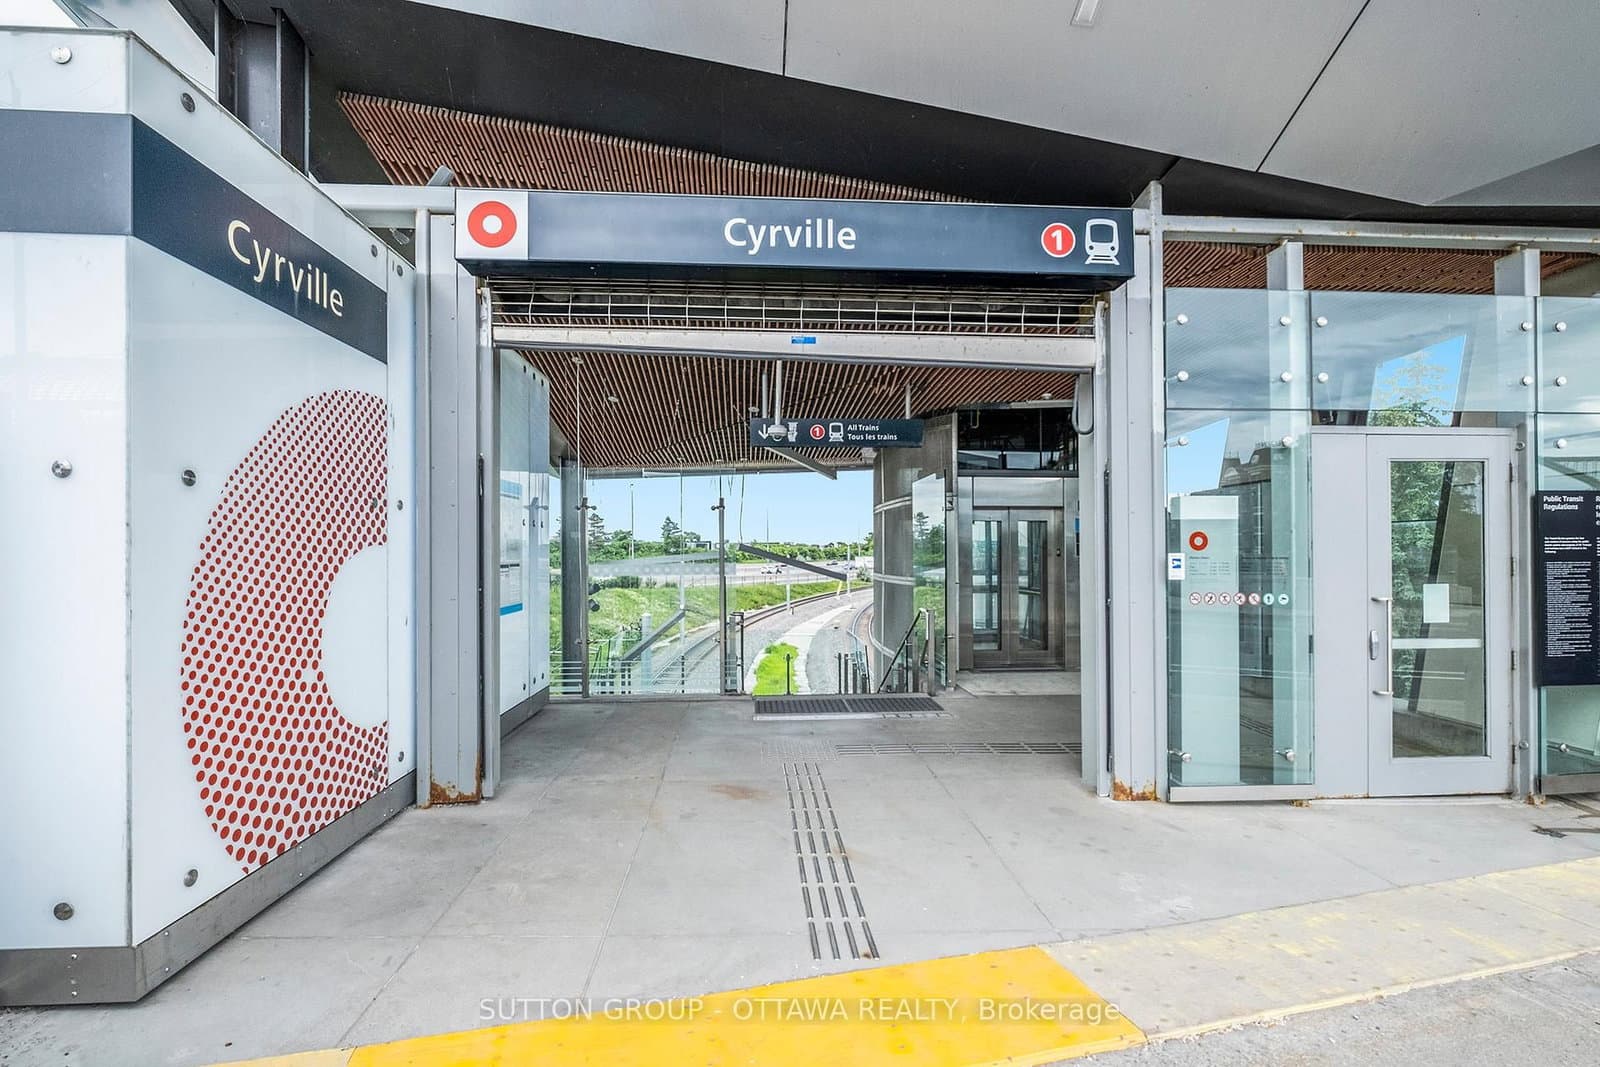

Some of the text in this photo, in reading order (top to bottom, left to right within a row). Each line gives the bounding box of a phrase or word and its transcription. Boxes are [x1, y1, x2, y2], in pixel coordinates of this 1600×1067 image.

[723, 217, 857, 255] Cyrville
[1051, 229, 1063, 251] 1
[227, 219, 344, 317] Cyrville
[847, 424, 880, 432] All Trains
[847, 433, 898, 441] Tous les trains
[1543, 503, 1579, 511] Regulations
